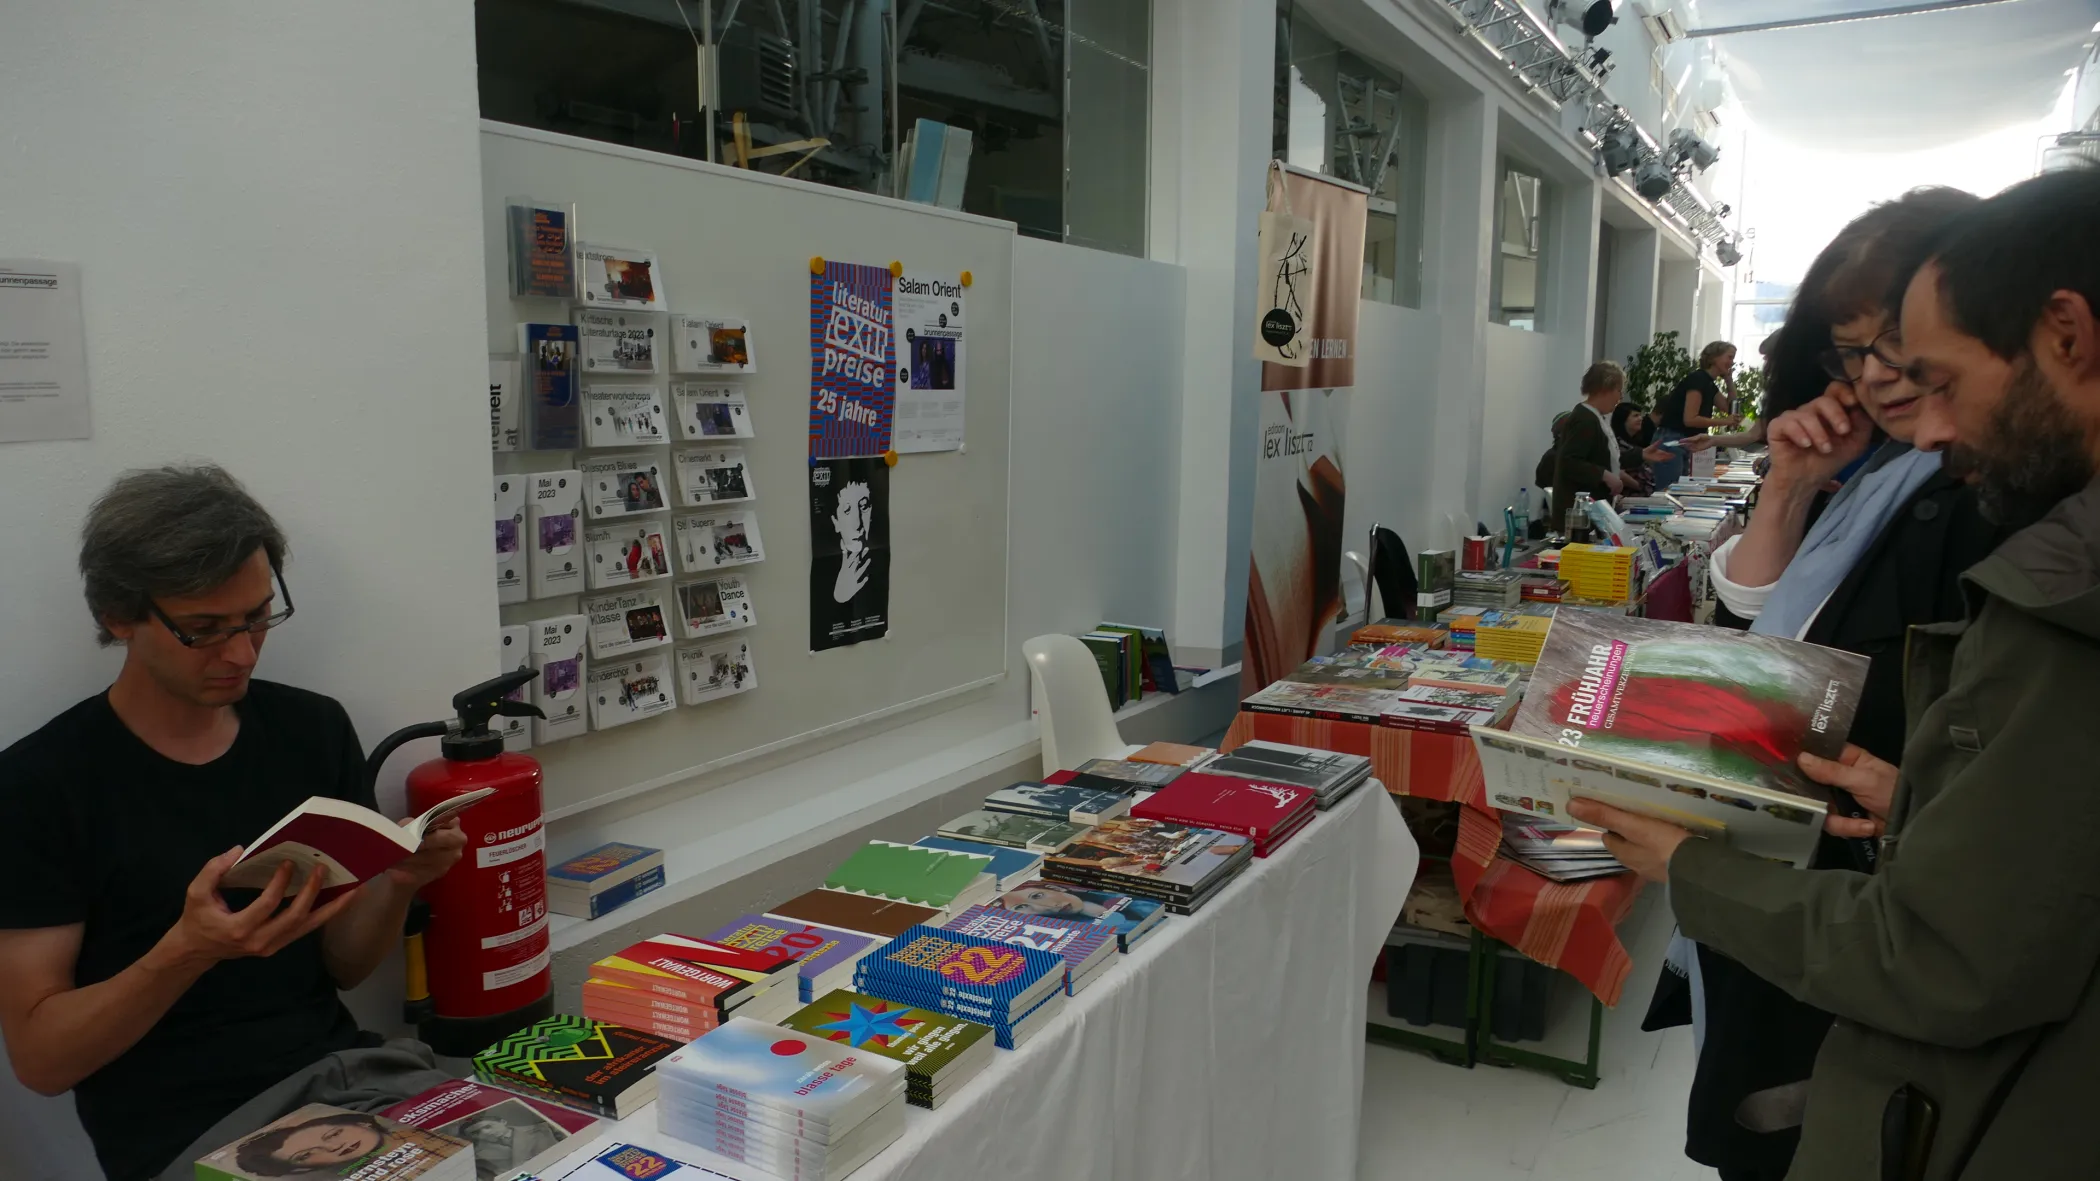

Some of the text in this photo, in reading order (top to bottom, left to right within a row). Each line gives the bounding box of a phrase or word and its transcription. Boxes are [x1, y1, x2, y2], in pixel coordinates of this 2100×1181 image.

[898, 276, 962, 299] Salam Orient
[832, 281, 889, 326] literatur
[628, 330, 644, 340] 2023
[822, 348, 886, 389] preise
[582, 391, 651, 401] Theaterworkshops
[817, 388, 838, 414] 25
[838, 396, 877, 427] jahre
[1263, 430, 1282, 459] lex
[1284, 428, 1313, 456] liszt
[538, 479, 552, 488] Mai
[538, 489, 556, 500] 2023
[718, 579, 741, 591] Youth
[587, 596, 637, 614] KinderTanz
[720, 590, 745, 602] Dance
[590, 613, 622, 626] Klasse
[544, 625, 558, 636] Mai
[543, 636, 561, 646] 2023
[587, 667, 629, 683] Kinderchor
[1567, 643, 1613, 727] FRÜHJAHR
[1588, 643, 1624, 728] neuerscheinungen
[1818, 679, 1836, 712] liszt
[1811, 714, 1826, 734] lex
[1558, 727, 1583, 748] 23
[1004, 924, 1069, 951] 21
[648, 957, 733, 989] WORTGEWALT
[938, 946, 1015, 983] 22
[652, 984, 687, 999] WORTGEWALT
[651, 1000, 688, 1014] WORTGEWALT
[956, 1003, 991, 1018] preistexte
[651, 1011, 689, 1025] WORTGEWALT
[652, 1022, 690, 1036] WORTGEWALT
[903, 1026, 947, 1056] wir gingen
[908, 1051, 928, 1066] weil
[924, 1041, 943, 1053] alle
[938, 1022, 969, 1043] gingen.
[585, 1069, 603, 1083] der
[794, 1071, 834, 1097] blasse
[829, 1056, 857, 1073] tage
[400, 1081, 480, 1125] cksmacher
[388, 1147, 425, 1169] rose
[625, 1156, 663, 1177] 22
